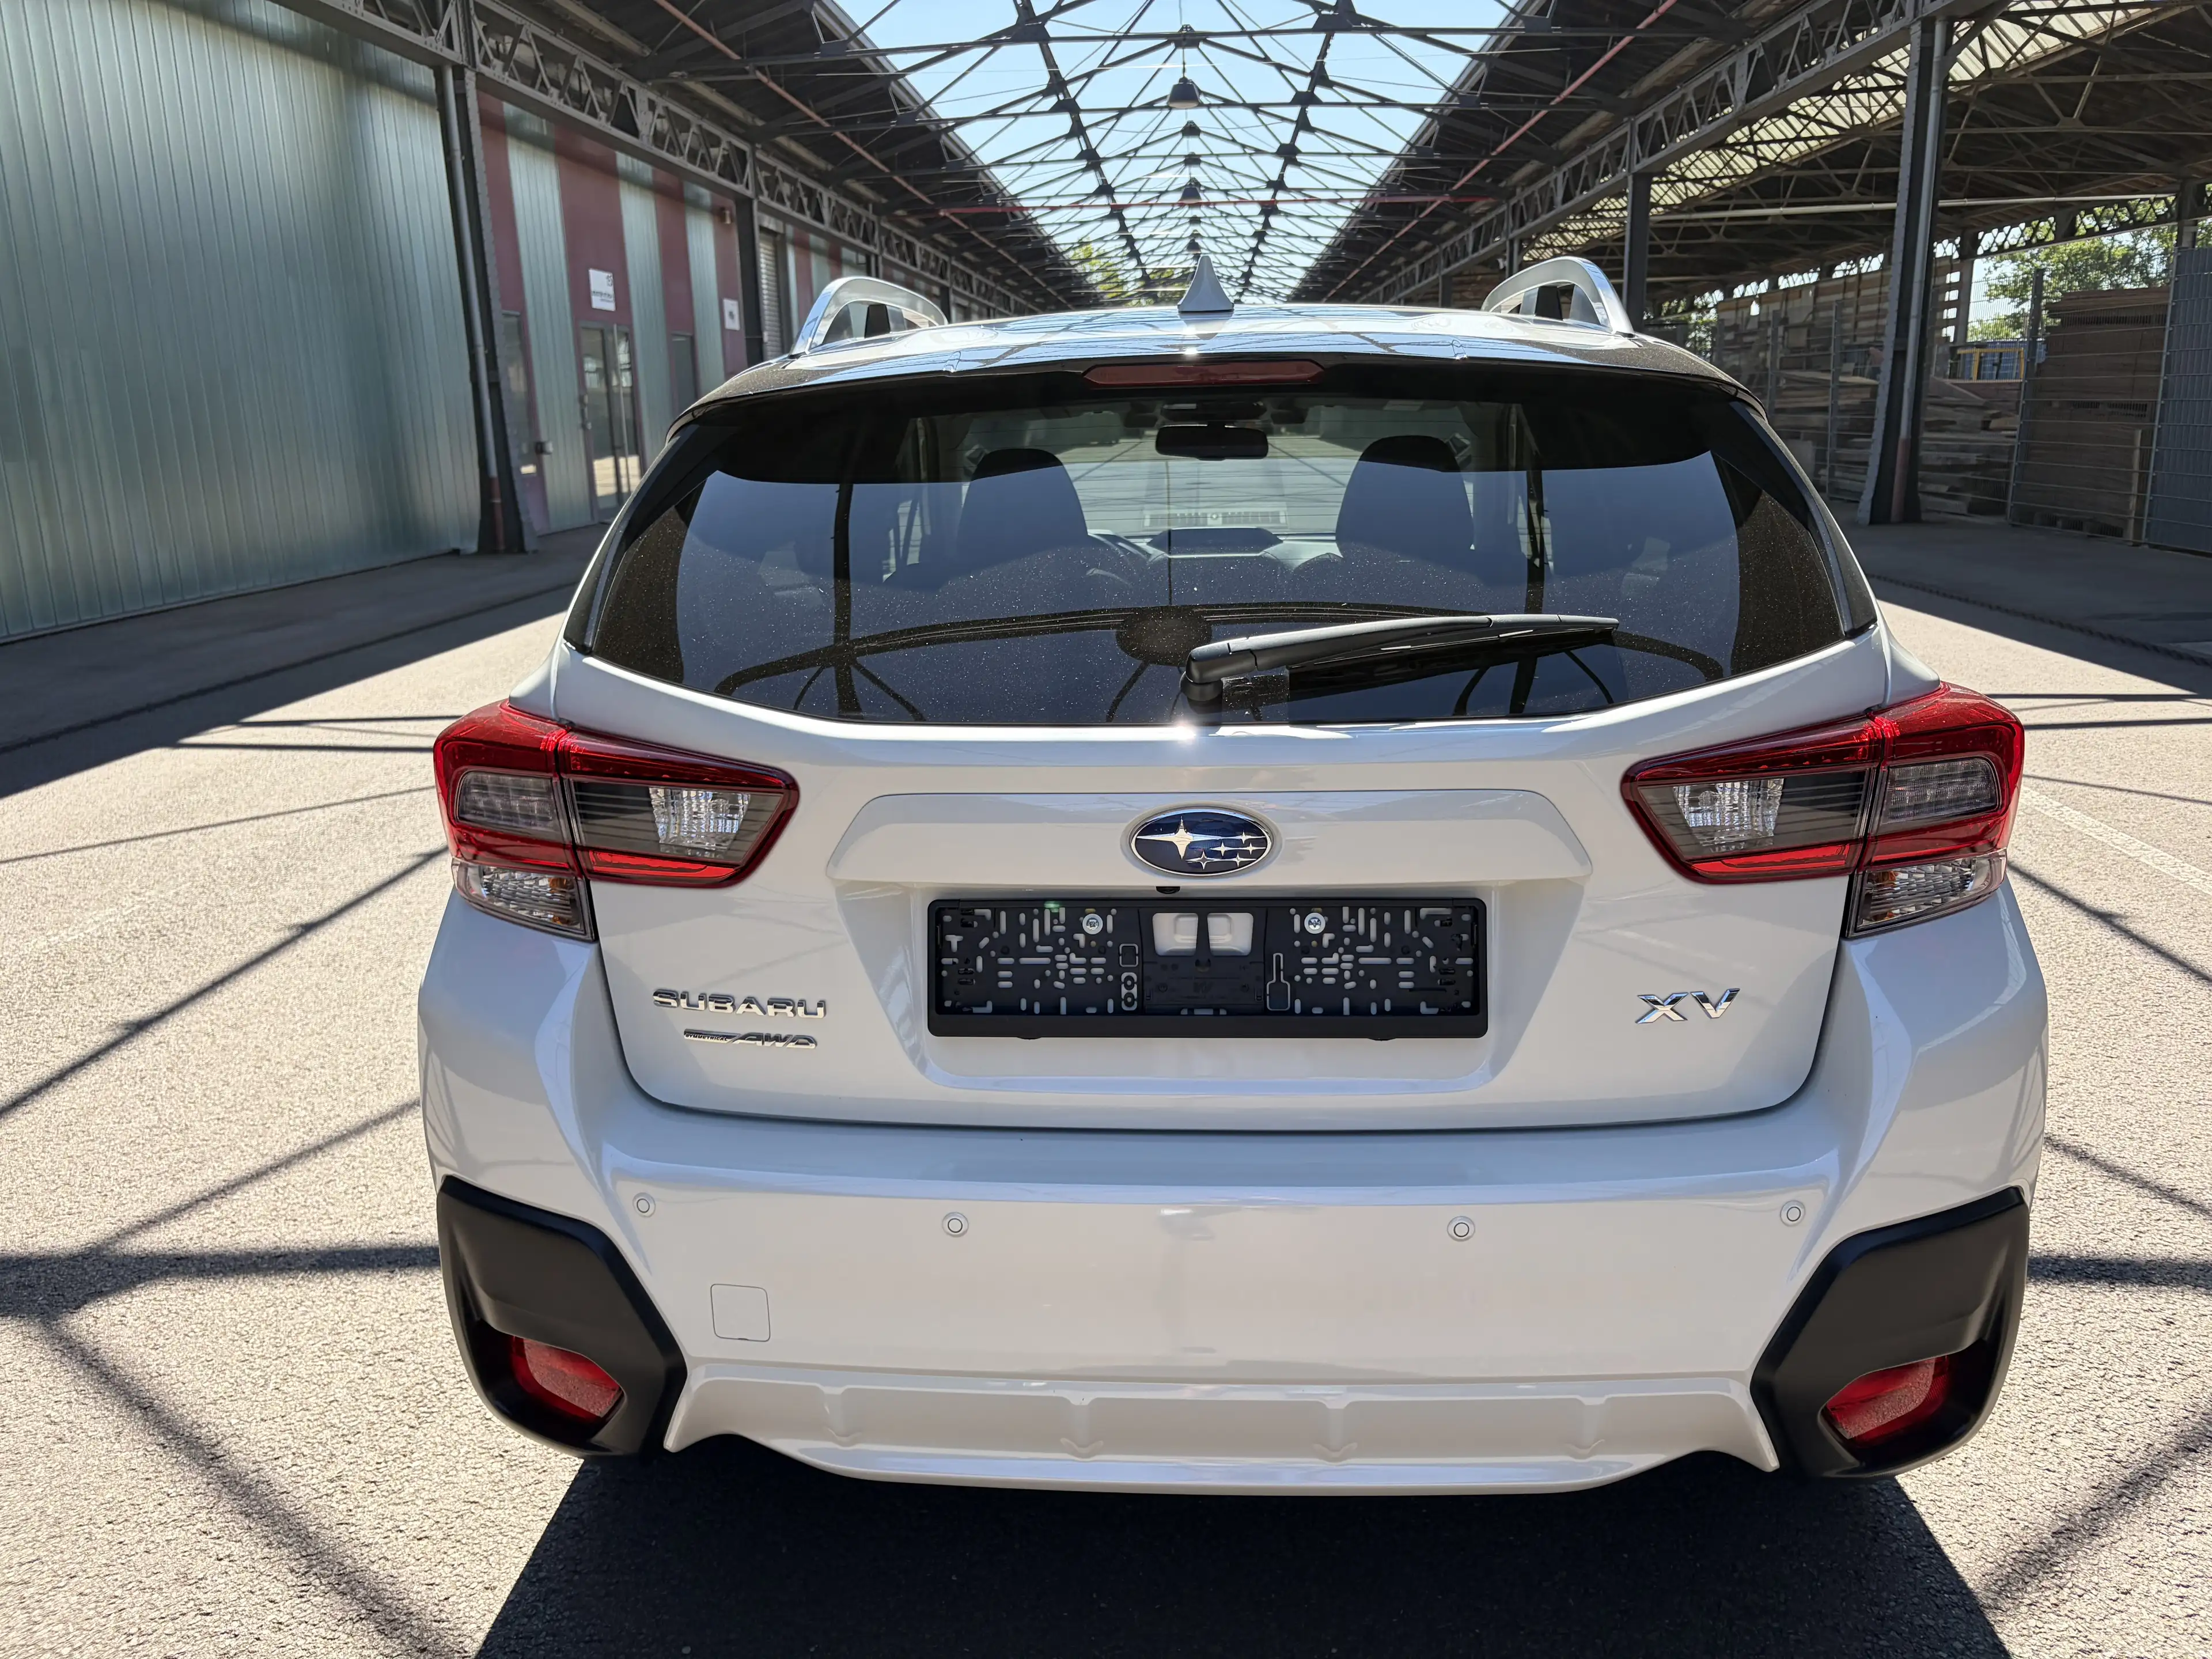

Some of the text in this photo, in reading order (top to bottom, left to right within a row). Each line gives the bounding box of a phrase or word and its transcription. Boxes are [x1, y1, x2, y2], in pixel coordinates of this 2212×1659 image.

[653, 989, 827, 1018] SUBARU
[1635, 988, 1740, 1024] XV
[685, 1032, 818, 1049] SYMMETRICAL AWD
